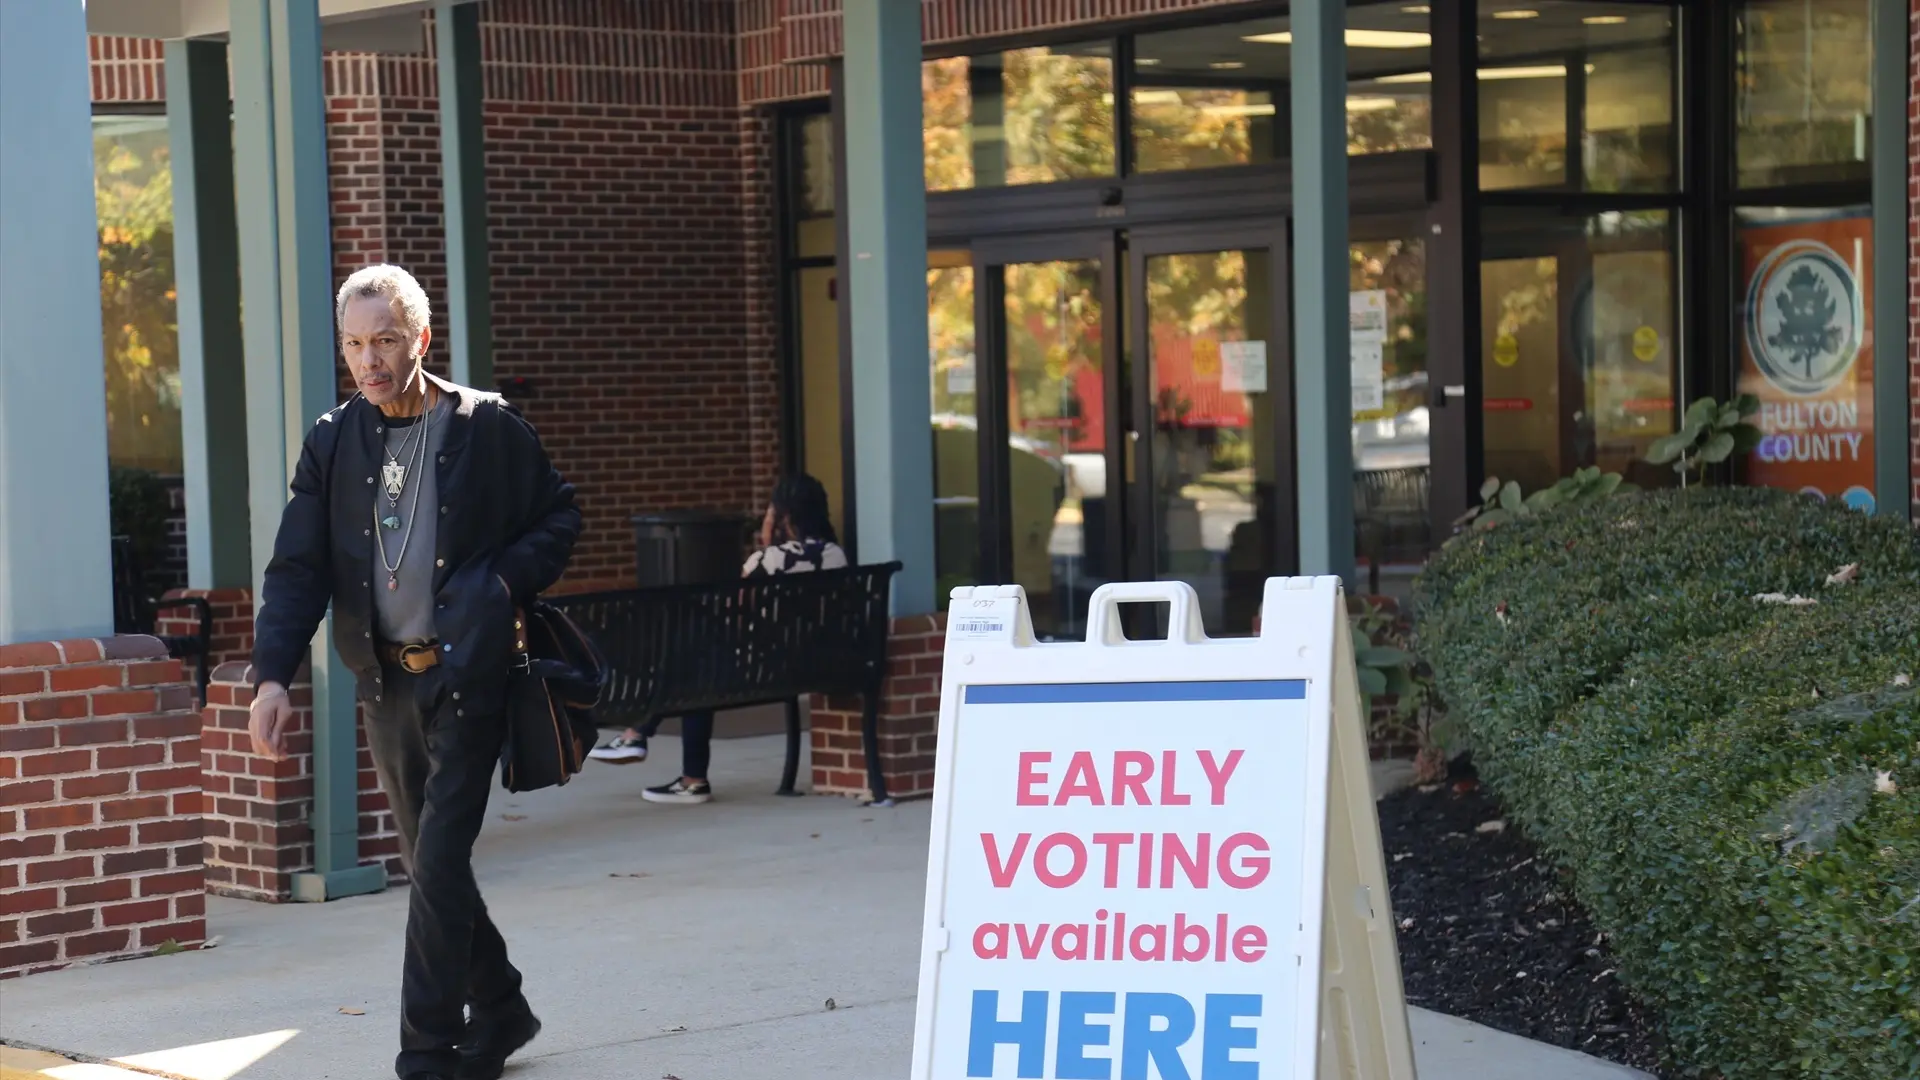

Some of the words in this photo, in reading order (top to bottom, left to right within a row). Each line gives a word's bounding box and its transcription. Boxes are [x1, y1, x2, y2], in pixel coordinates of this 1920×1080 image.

[1759, 400, 1859, 430] FULTON
[1758, 432, 1863, 462] COUNTY
[1016, 749, 1246, 806] EARLY
[980, 832, 1271, 889] VOTING
[972, 908, 1267, 963] available
[967, 990, 1263, 1080] HERE
